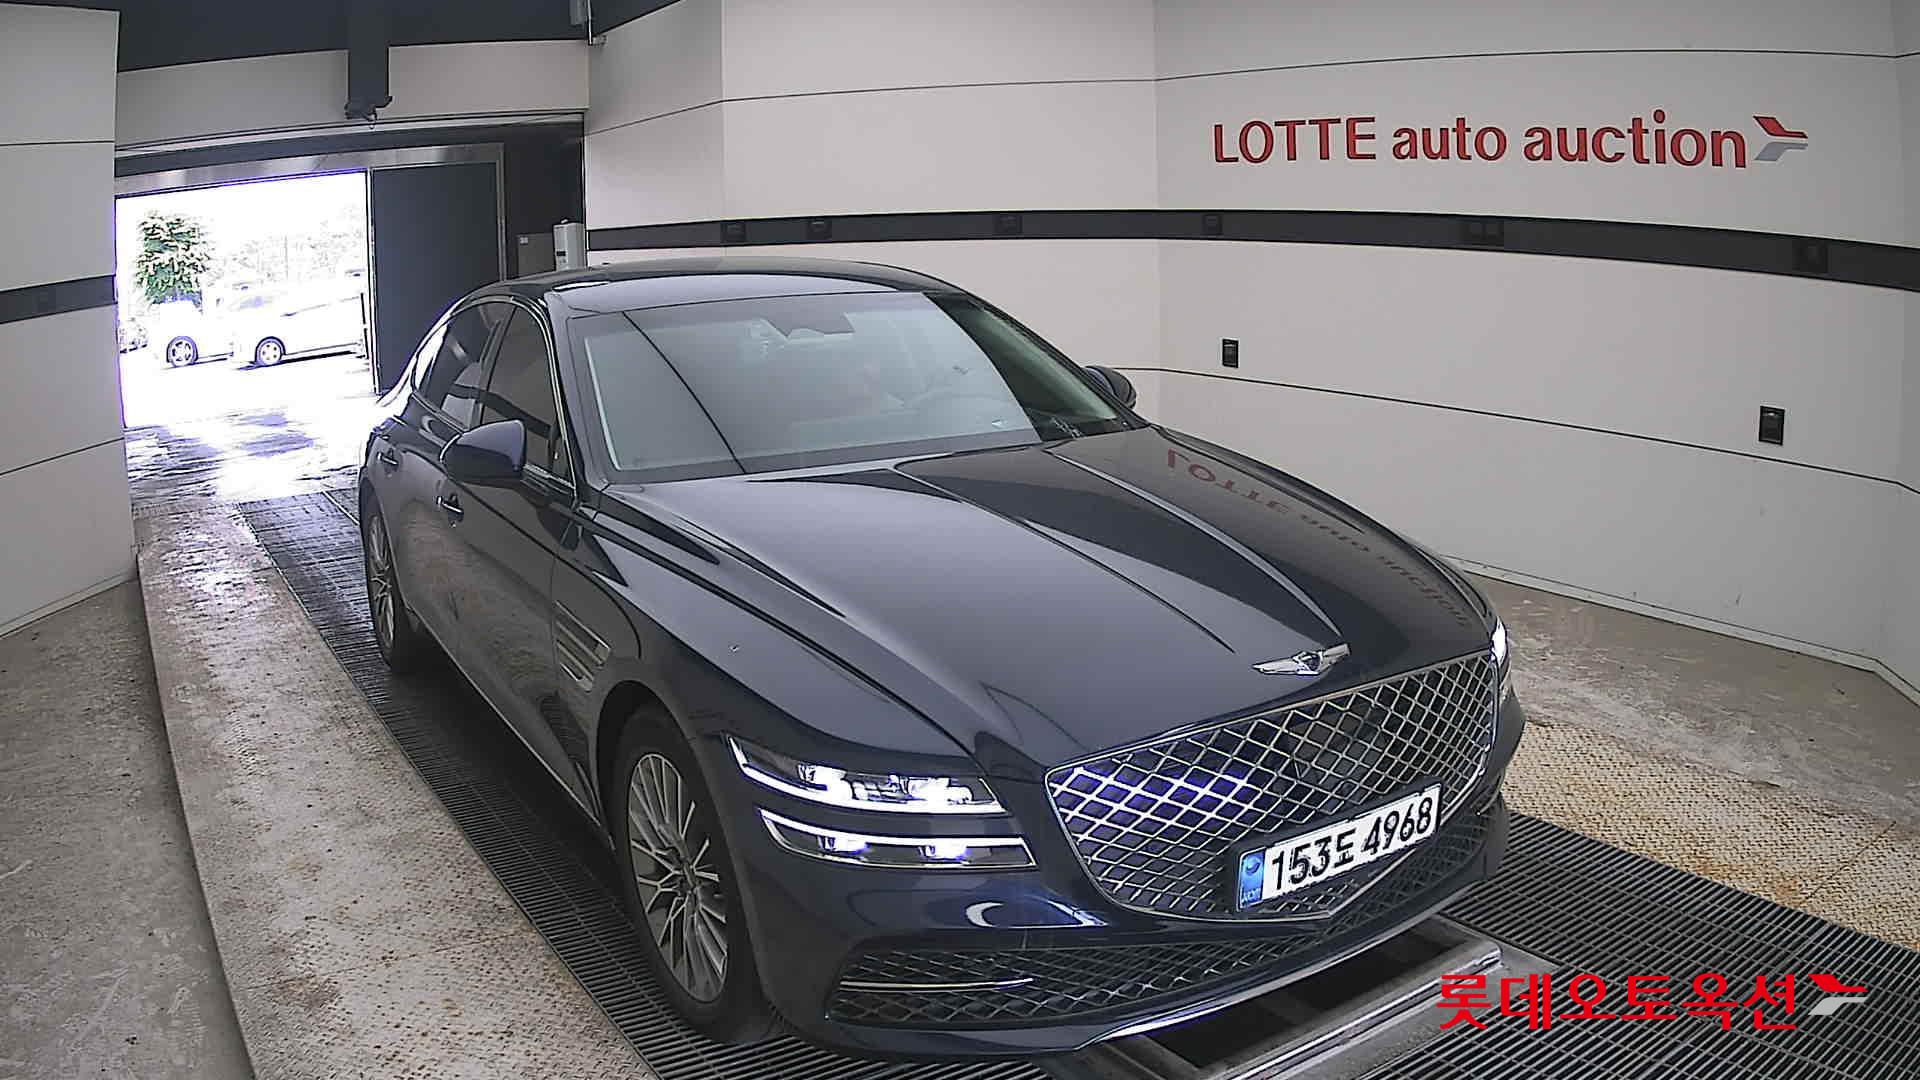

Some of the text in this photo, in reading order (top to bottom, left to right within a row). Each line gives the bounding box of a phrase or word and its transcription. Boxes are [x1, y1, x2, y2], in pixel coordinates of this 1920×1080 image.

[1213, 110, 1747, 169] LOTTE auto auction
[1272, 797, 1433, 891] 153도 4968
